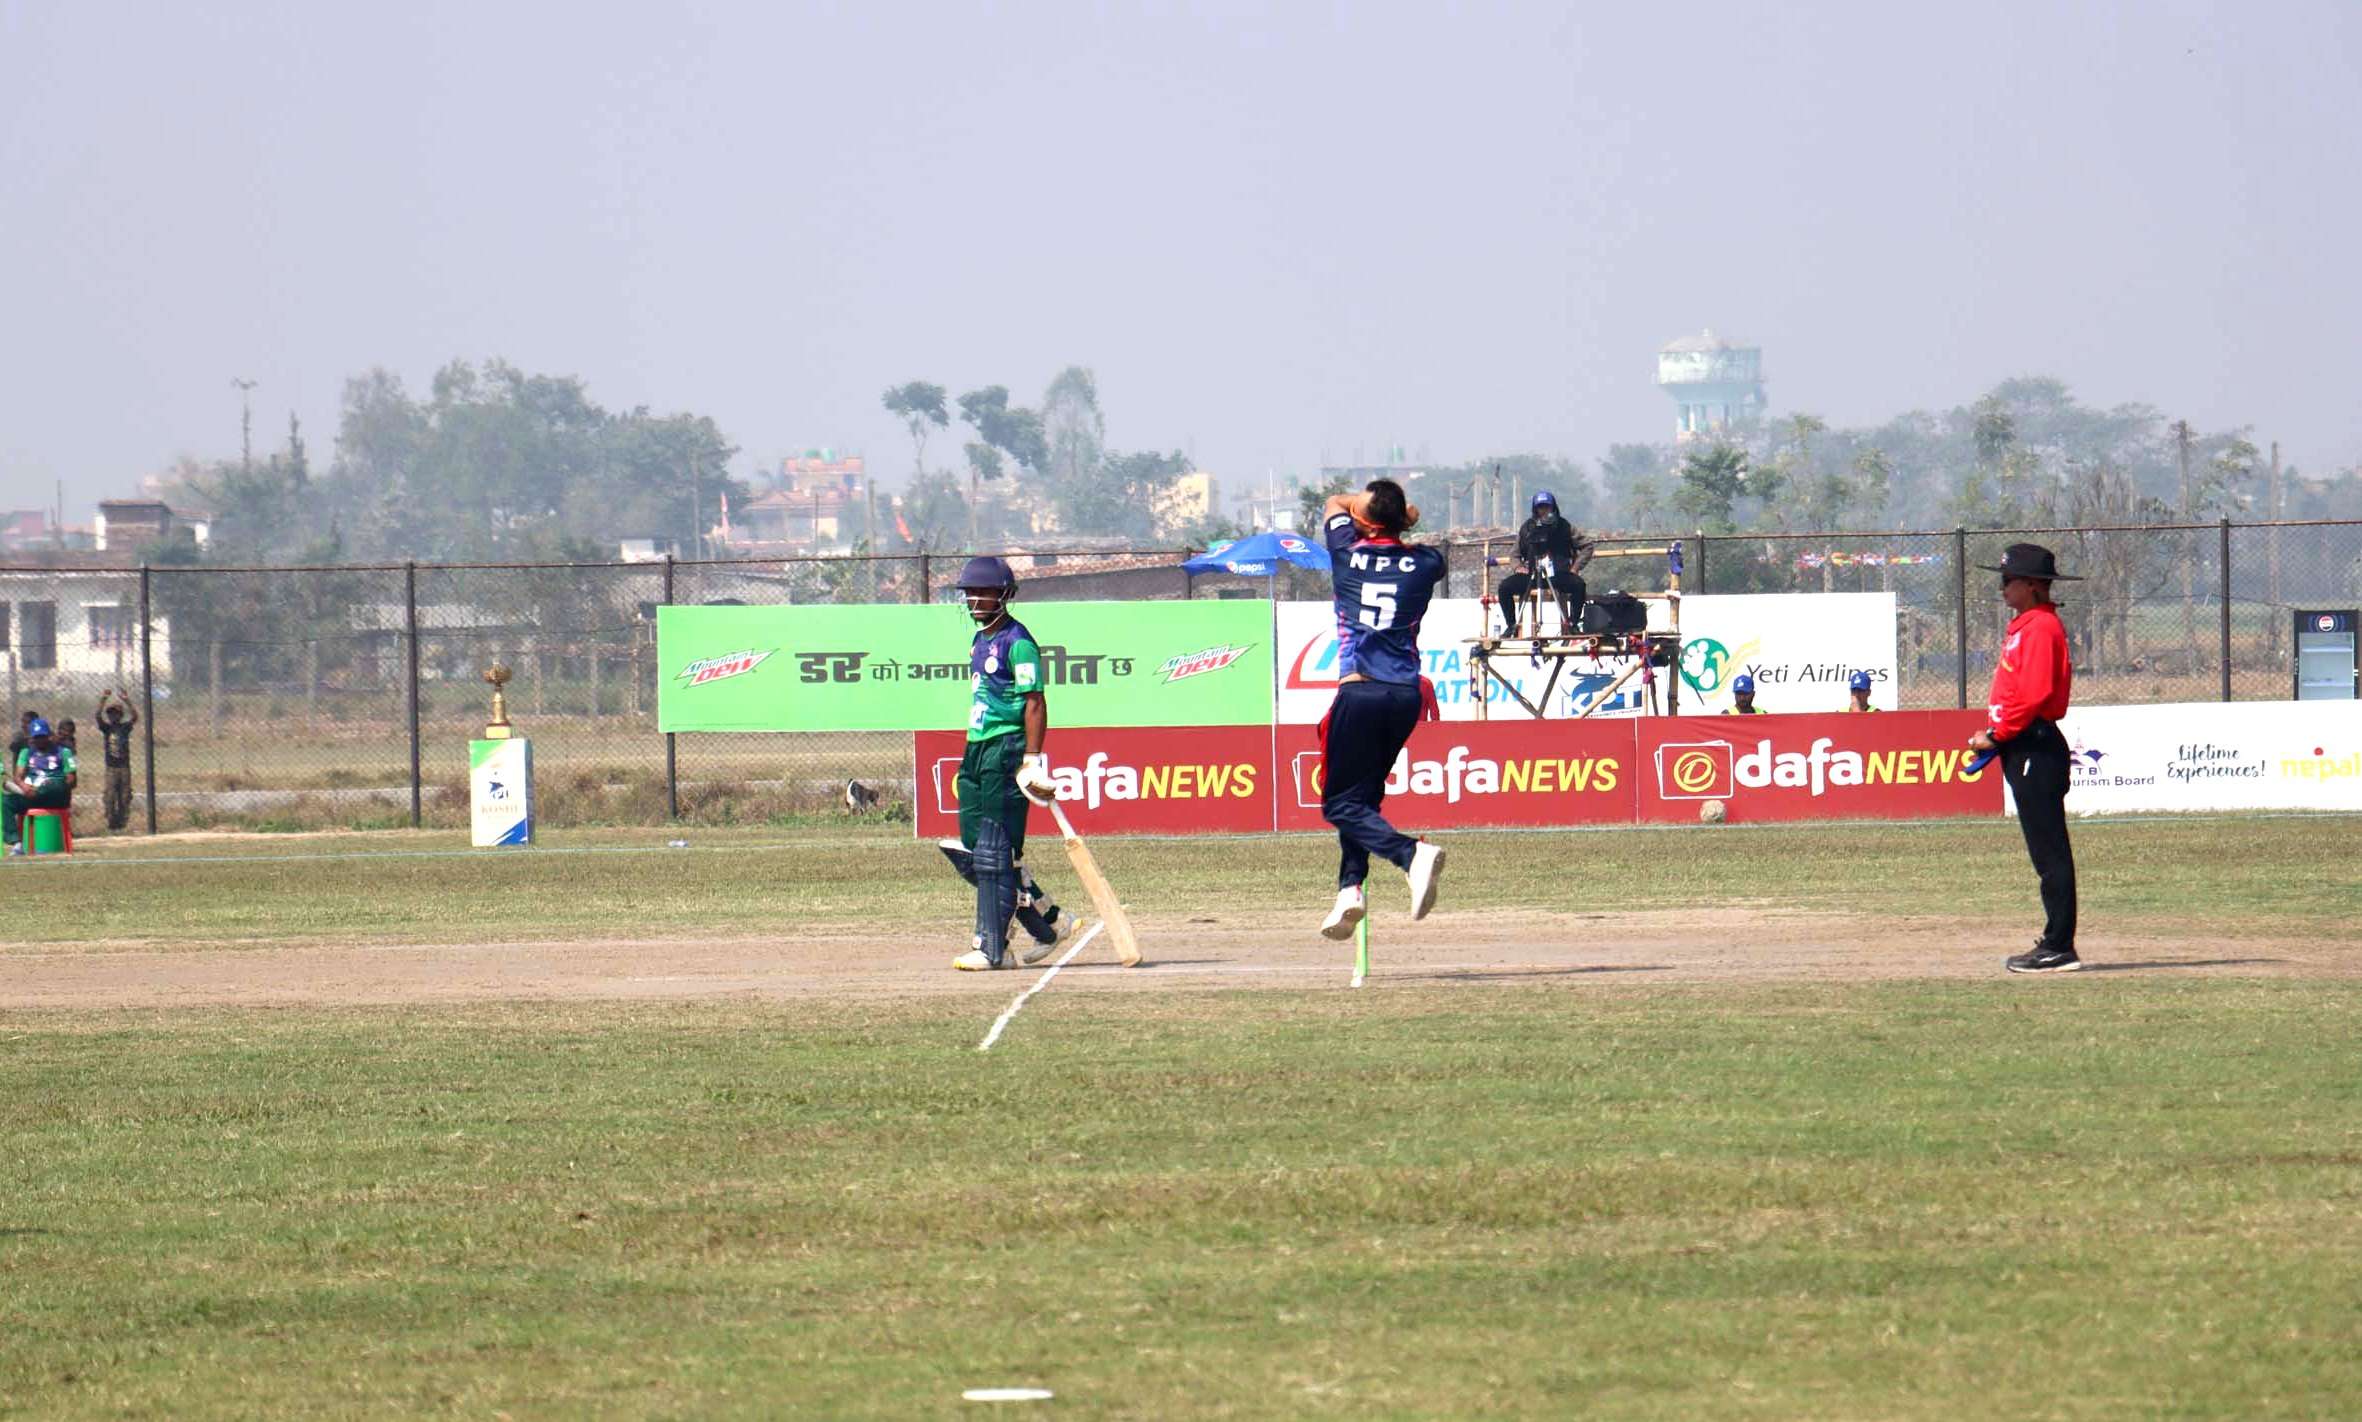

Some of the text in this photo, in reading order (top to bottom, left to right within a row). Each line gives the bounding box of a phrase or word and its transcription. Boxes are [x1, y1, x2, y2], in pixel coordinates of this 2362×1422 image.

[1358, 582, 1398, 631] 5
[795, 645, 1136, 685] डर को अगा ीत छ
[1746, 664, 1789, 684] Yeti
[2179, 744, 2240, 762] Lifetime
[2167, 760, 2265, 783] Experiences!
[2280, 752, 2361, 783] nepal
[2072, 776, 2155, 787] urism Board
